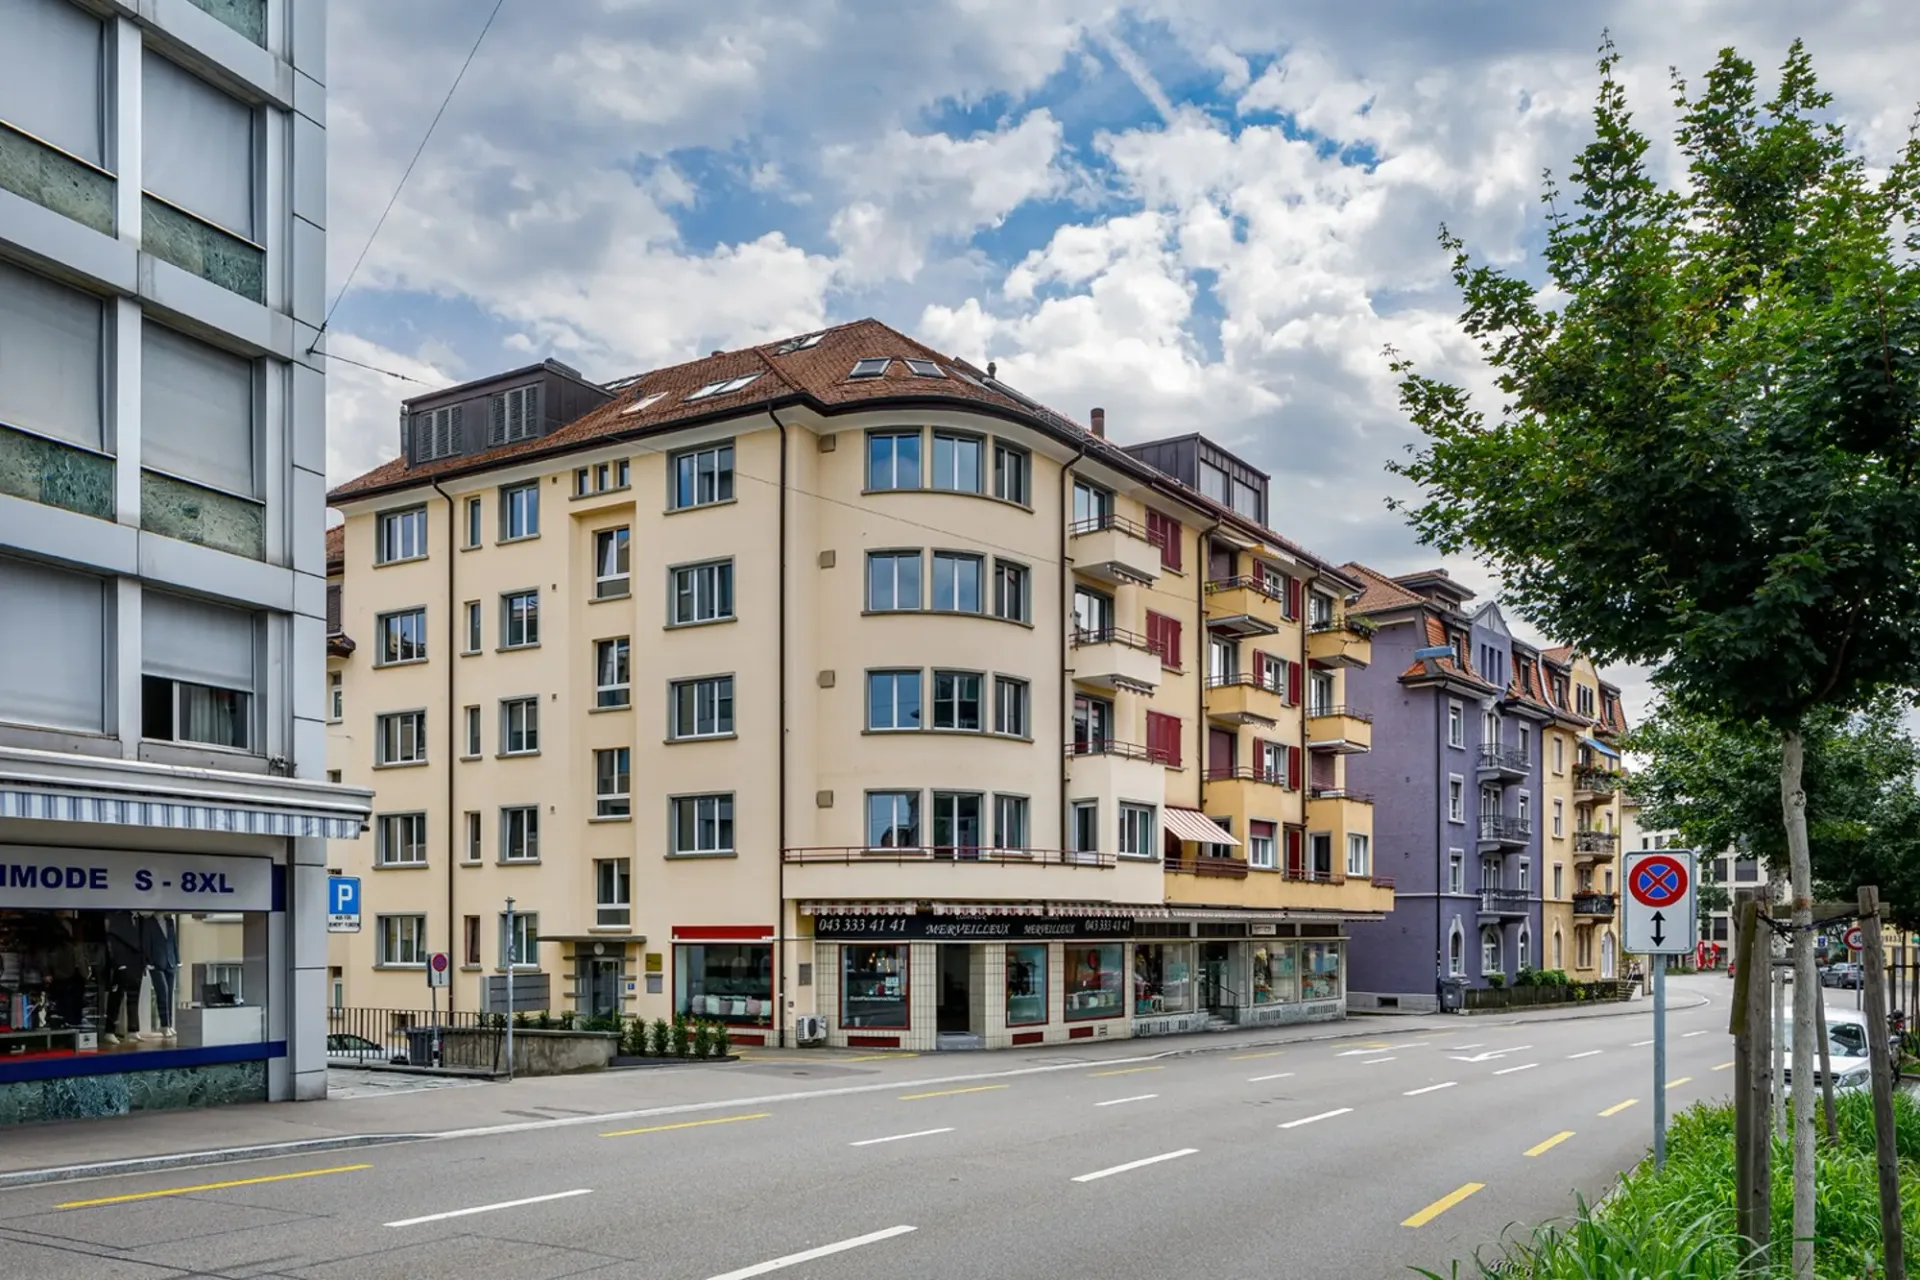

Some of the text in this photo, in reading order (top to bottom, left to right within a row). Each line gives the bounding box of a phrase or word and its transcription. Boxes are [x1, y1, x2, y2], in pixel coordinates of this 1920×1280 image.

[0, 864, 108, 889] MODE
[135, 870, 152, 891] S
[181, 872, 234, 893] 8XL
[338, 884, 352, 910] P
[819, 919, 906, 931] 043 333 41 41
[925, 923, 1010, 936] MERVEILLEUX
[1023, 923, 1076, 935] MERVEILLEUX
[1085, 920, 1130, 931] 043 333 41 41
